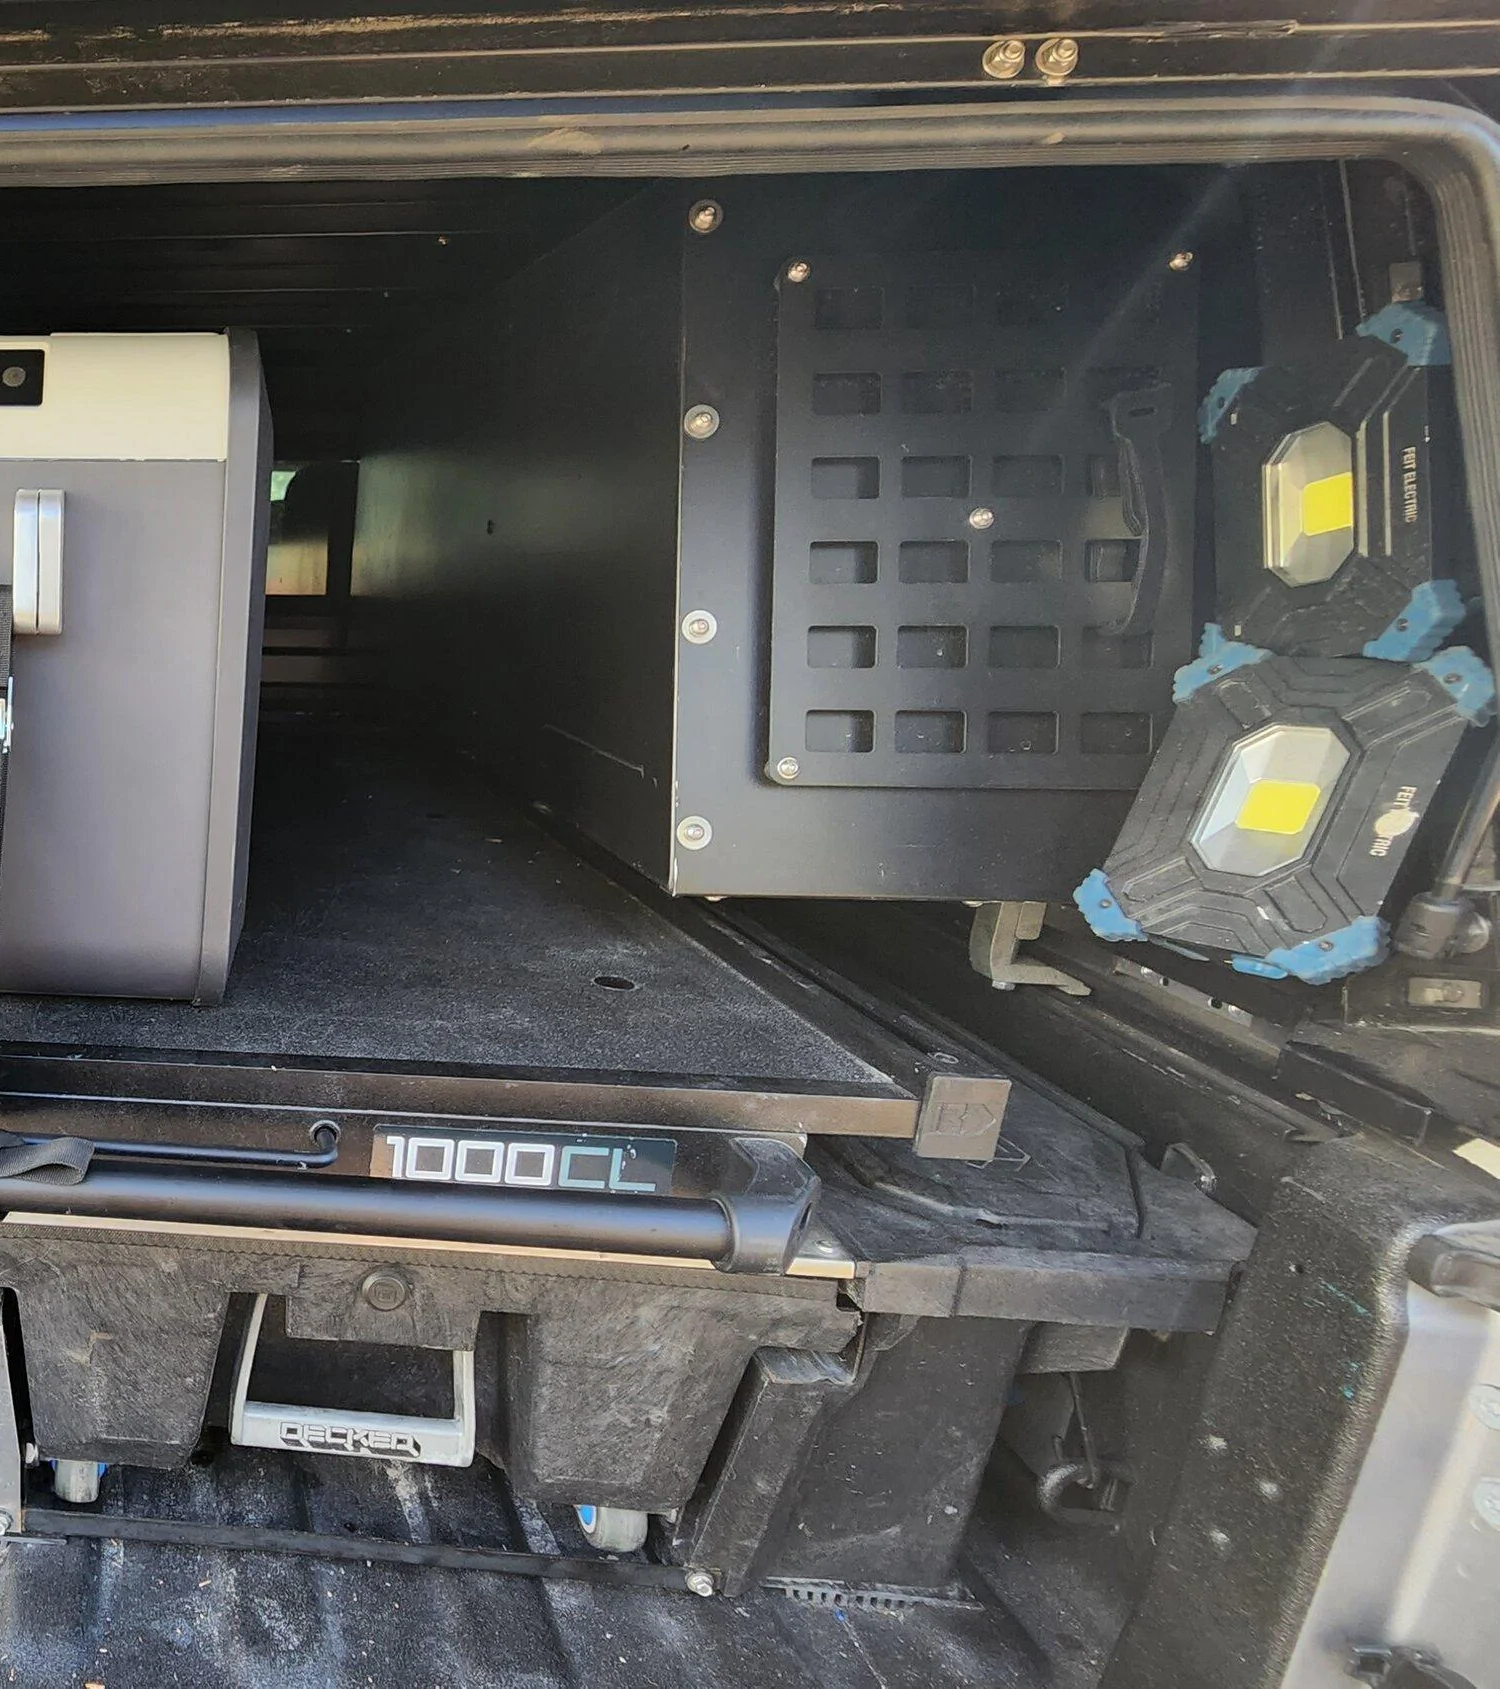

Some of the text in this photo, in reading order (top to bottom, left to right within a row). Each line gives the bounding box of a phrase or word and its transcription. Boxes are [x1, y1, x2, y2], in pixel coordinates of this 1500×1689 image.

[1402, 446, 1418, 523] FEIT ELECTRIC
[386, 1135, 656, 1192] 1000CL
[280, 1422, 422, 1458] DECKED
